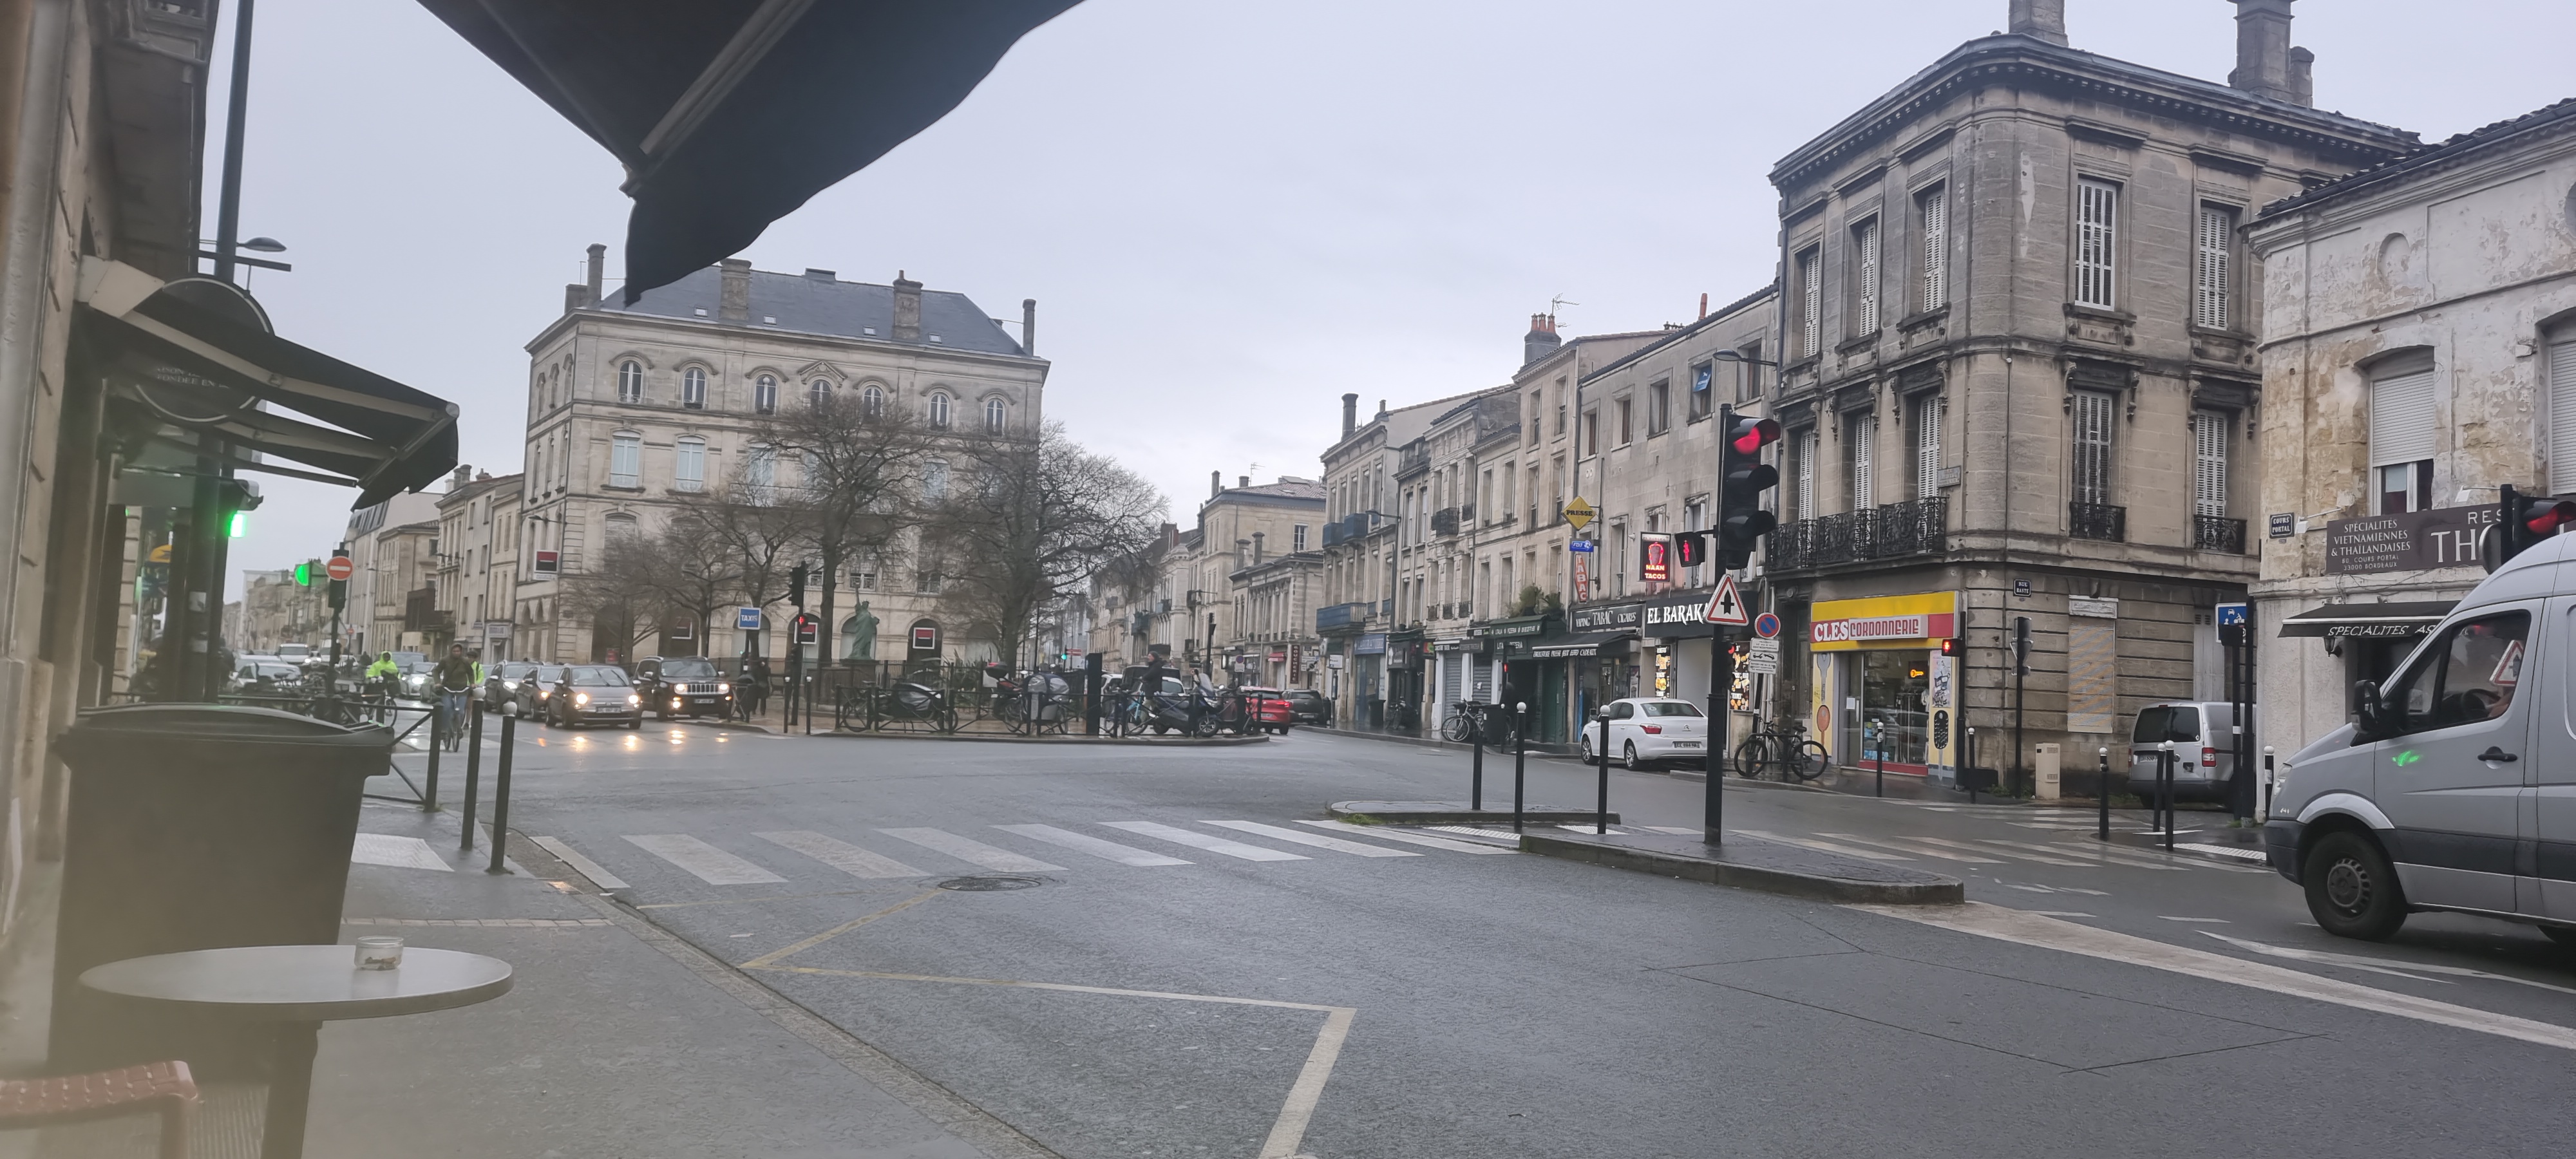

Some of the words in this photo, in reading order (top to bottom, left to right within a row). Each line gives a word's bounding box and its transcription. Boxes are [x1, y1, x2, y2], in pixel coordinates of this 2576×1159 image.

[2344, 517, 2398, 533] SPÉCIALITÉS
[2334, 529, 2409, 545] VIETNAMIENNES
[2331, 547, 2338, 557] &
[2340, 541, 2411, 556] THAÏLANDAISES
[1576, 554, 1587, 600] TABAC
[1593, 610, 1613, 626] TABAC
[1617, 612, 1636, 623] CIGARES
[1647, 607, 1661, 624] EL
[1814, 621, 1848, 642] CLES
[1850, 619, 1919, 637] CORDONNERIE
[2327, 625, 2410, 636] SPECIALITES
